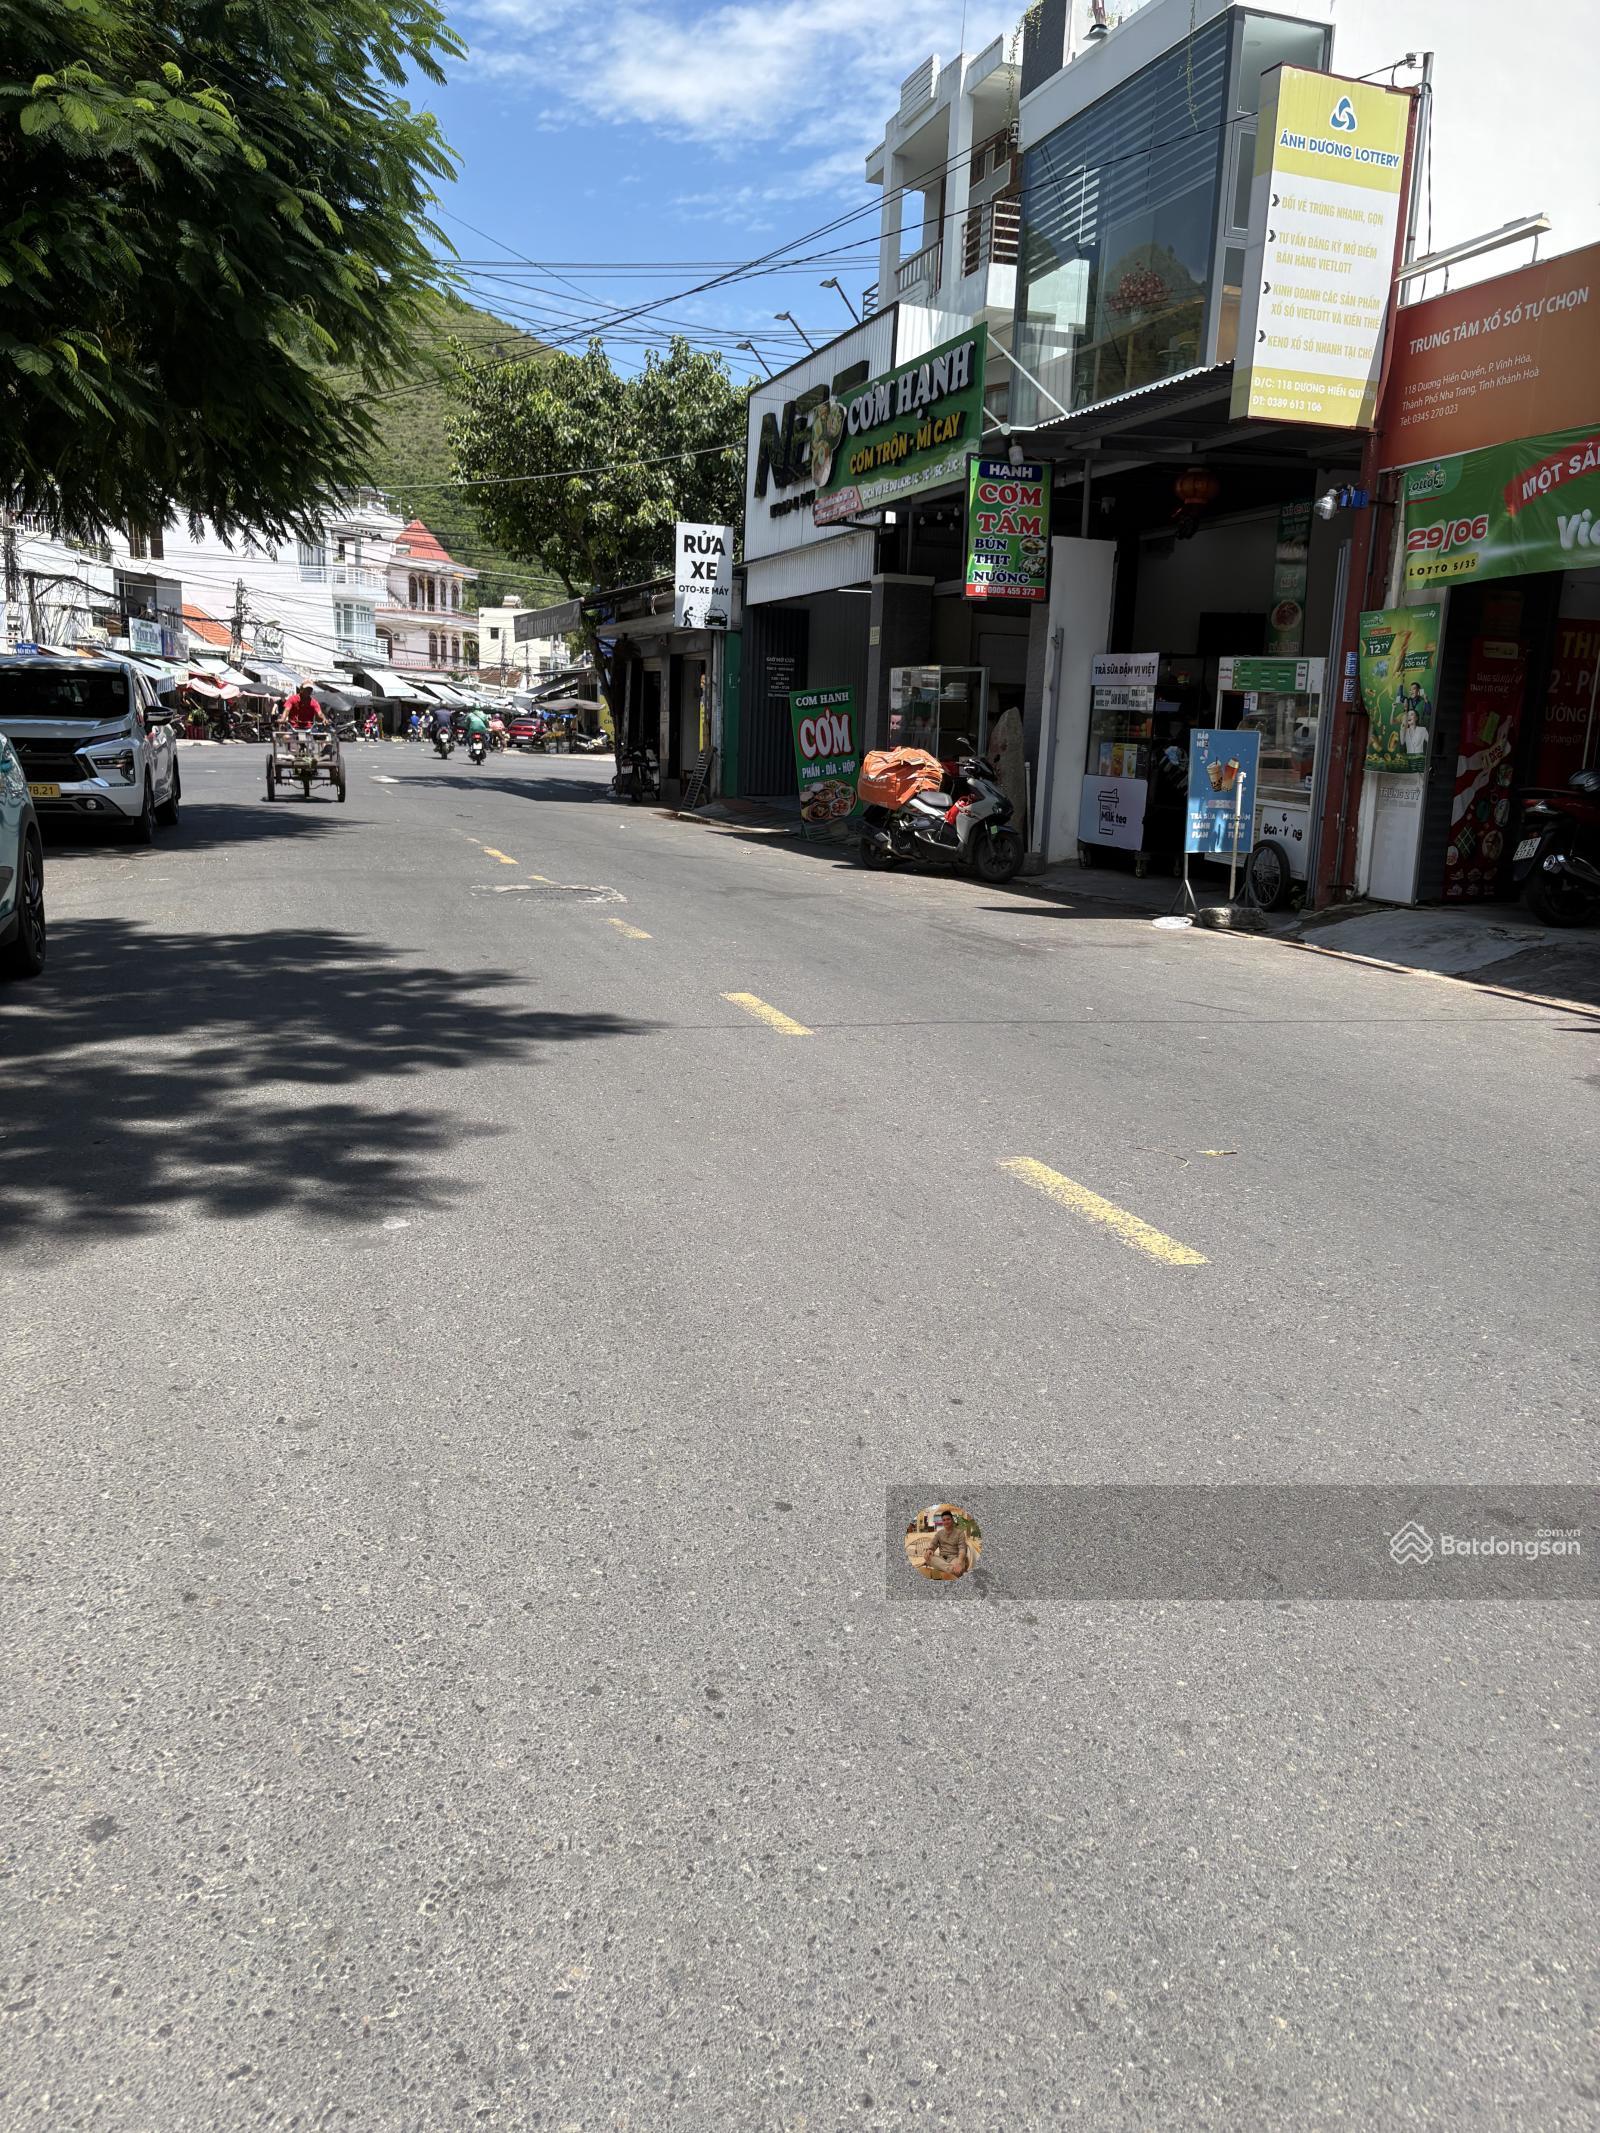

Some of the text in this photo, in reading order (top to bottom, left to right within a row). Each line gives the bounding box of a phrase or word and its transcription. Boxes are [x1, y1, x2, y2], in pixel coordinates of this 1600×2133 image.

[1280, 130, 1400, 168] ÁNH DƯƠNG LOTTERY
[1318, 257, 1352, 273] VIETLOTT
[1273, 282, 1293, 297] KINH
[1410, 287, 1590, 355] TRUNG TÂM XỔ SỐ TỰ CHỌN
[1267, 334, 1289, 348] KENO
[847, 340, 976, 436] CƠM HẠNH
[1277, 379, 1292, 391] 118
[1404, 384, 1418, 397] 118
[1440, 388, 1454, 403] Nha
[1413, 410, 1430, 424] 0345
[1430, 406, 1444, 420] 270
[1444, 403, 1458, 417] 023
[849, 442, 873, 475] CƠM
[875, 432, 908, 467] TRỘN
[917, 418, 933, 450] MÌ
[933, 411, 963, 444] CAY
[989, 464, 1033, 479] HẠNH
[1522, 442, 1600, 501] MỘT SẢ
[979, 481, 1042, 507] CƠM
[977, 507, 1042, 536] TẤM
[1407, 514, 1489, 555] 29/06
[683, 530, 726, 556] RỬA
[974, 536, 1008, 551] BÚN
[974, 553, 1010, 569] THỊT
[1409, 557, 1477, 577] LOTTO 5/35
[690, 560, 718, 580] XE
[974, 568, 1029, 584] NƯỚNG
[711, 585, 729, 596] MÁY
[1370, 645, 1381, 655] 12
[1095, 662, 1106, 675] TRÀ
[1106, 662, 1119, 675] SỮA
[1142, 662, 1156, 678] VIỆT
[799, 705, 853, 759] CƠM
[1115, 813, 1127, 825] tea
